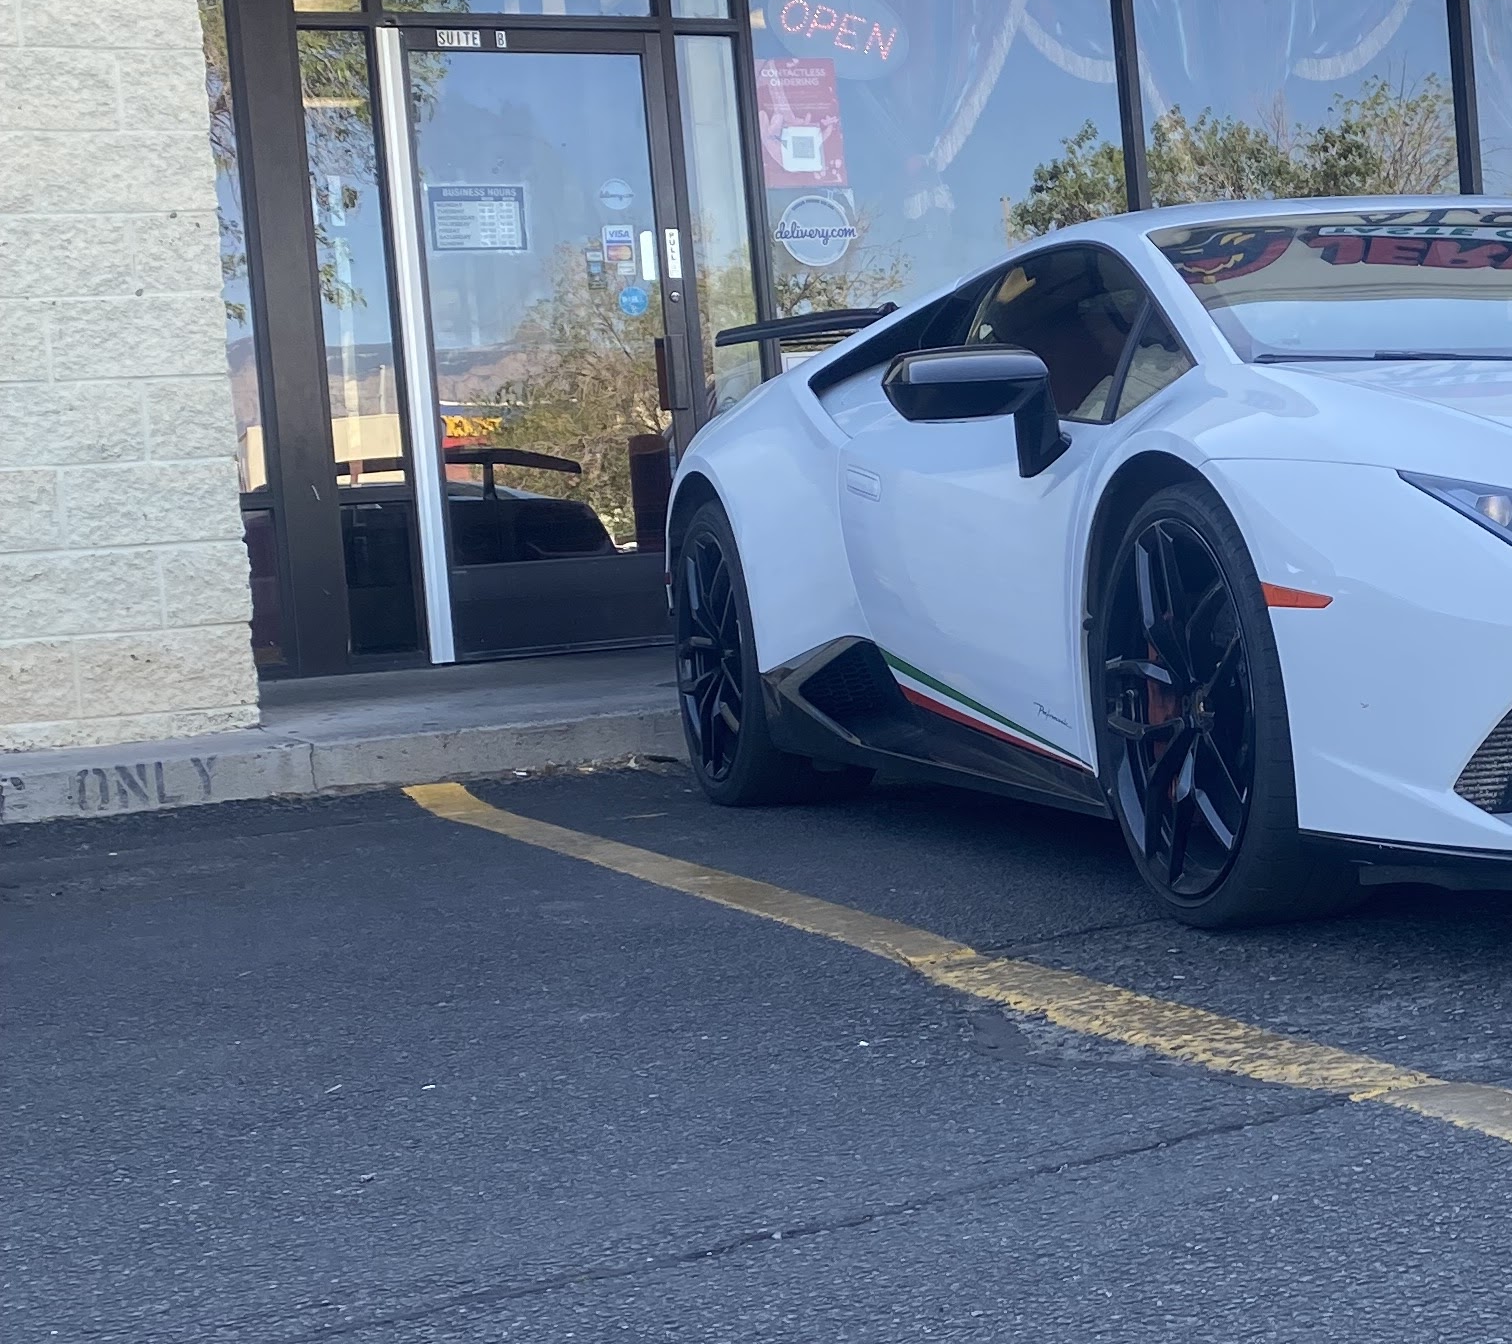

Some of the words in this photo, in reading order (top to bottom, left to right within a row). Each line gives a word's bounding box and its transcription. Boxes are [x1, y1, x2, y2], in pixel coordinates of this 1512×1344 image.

[781, 0, 897, 60] OPEN
[438, 30, 479, 46] SUITE
[761, 68, 826, 77] CONTACTLESS
[770, 77, 819, 86] ORDERING
[442, 187, 485, 197] BUSINESS
[487, 187, 517, 197] HOURS
[608, 229, 630, 238] VISA
[775, 221, 857, 246] delivery.com
[76, 754, 219, 812] ONLY
